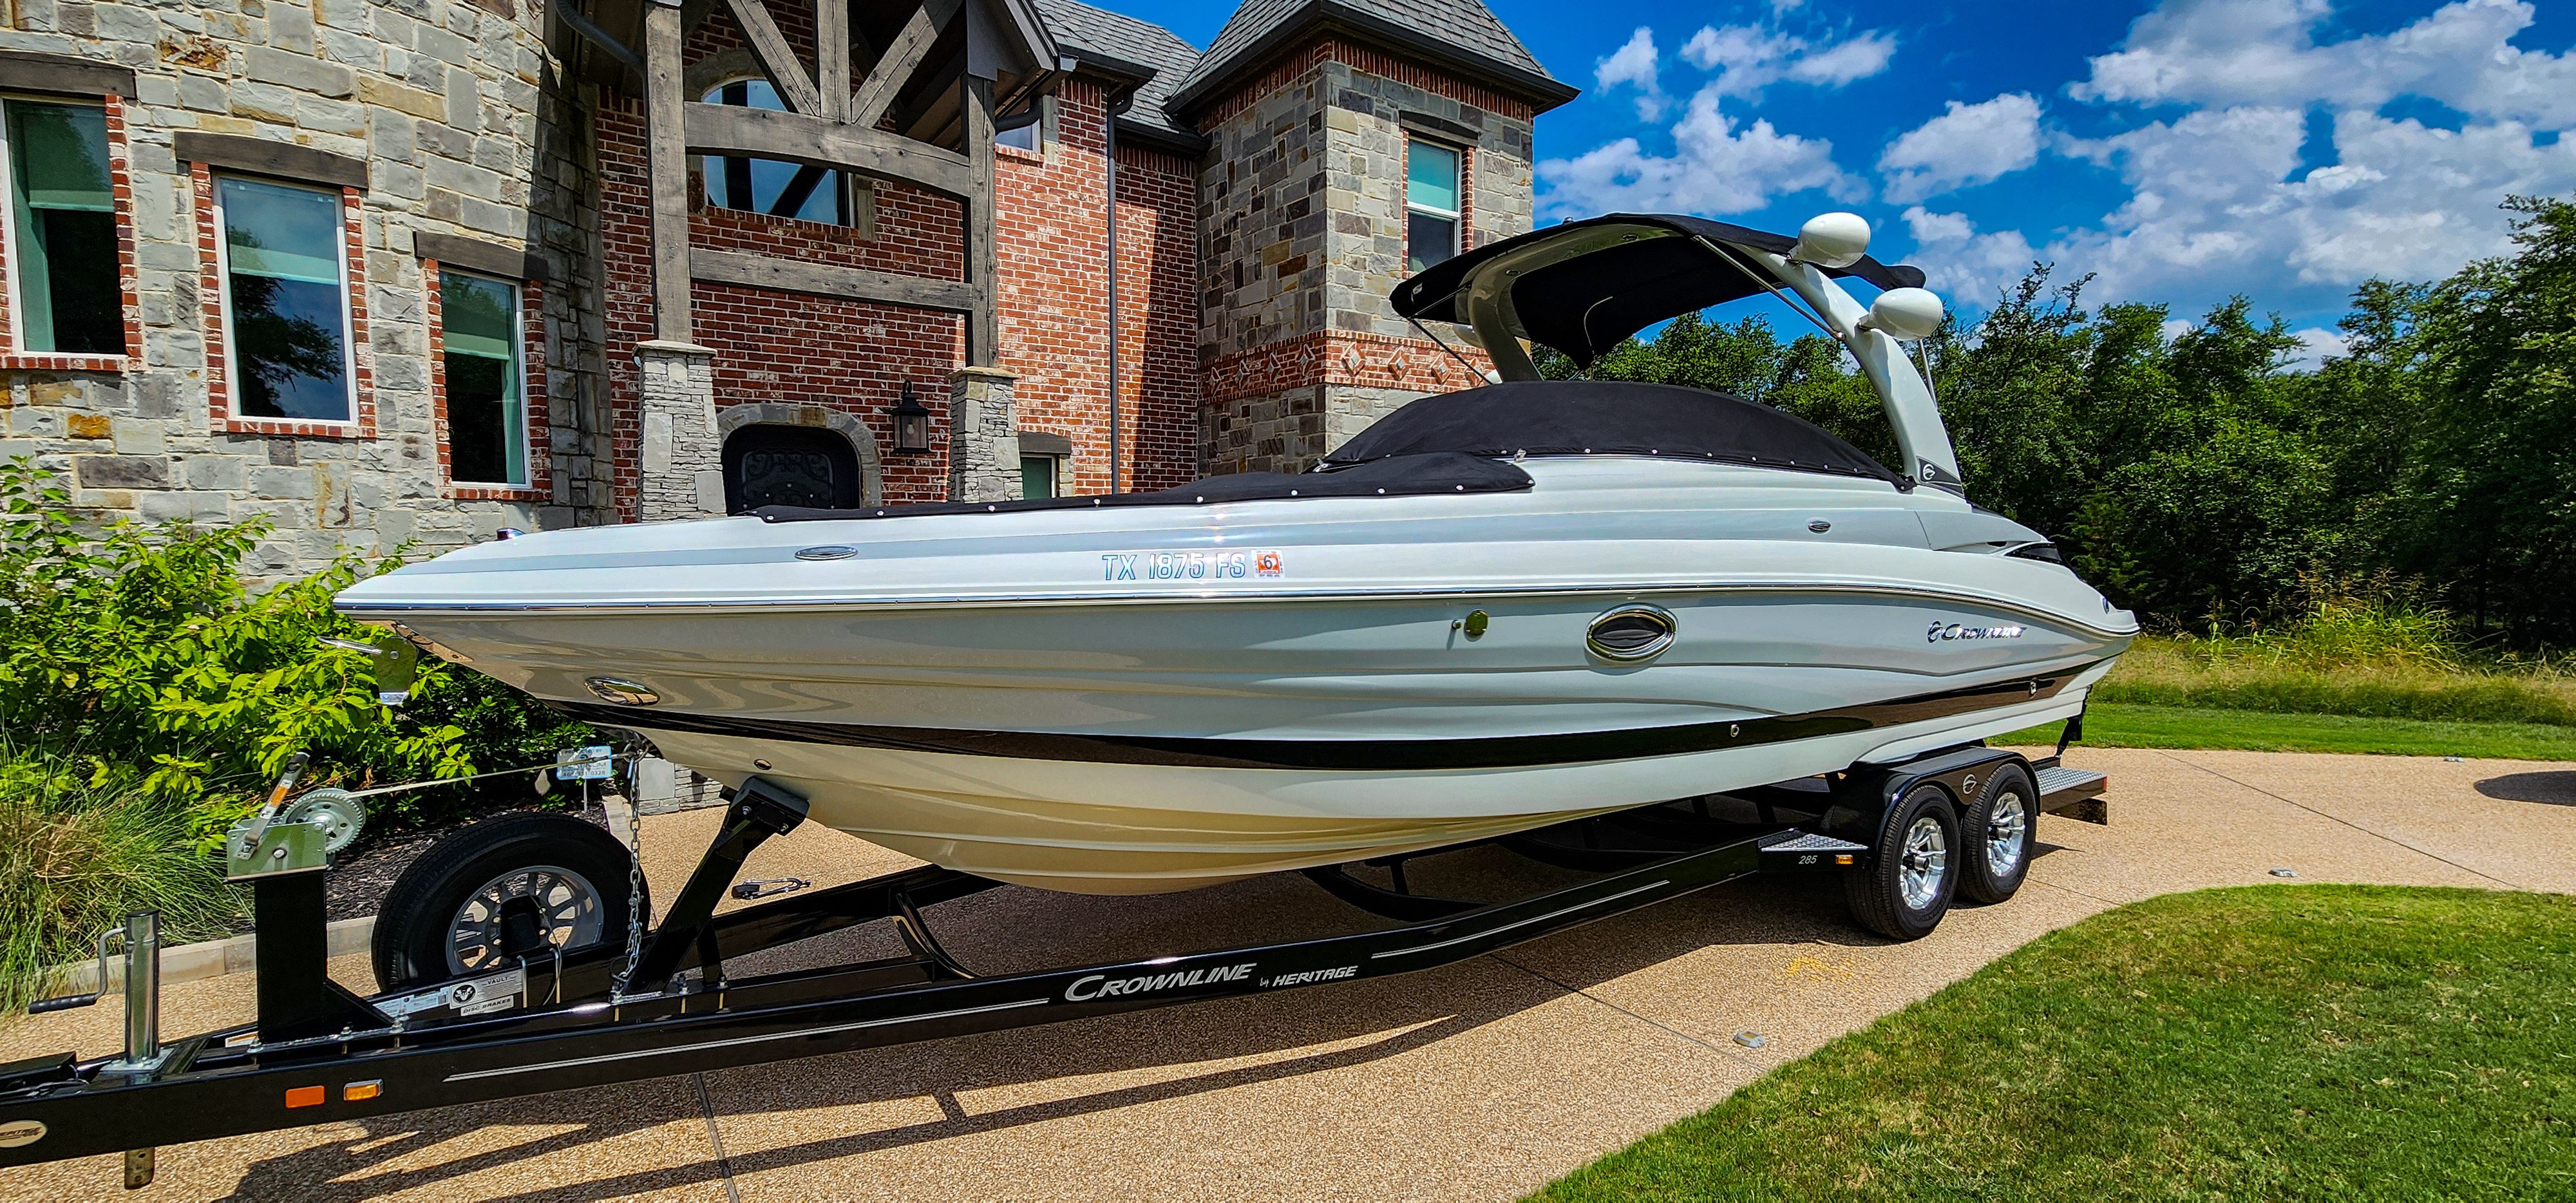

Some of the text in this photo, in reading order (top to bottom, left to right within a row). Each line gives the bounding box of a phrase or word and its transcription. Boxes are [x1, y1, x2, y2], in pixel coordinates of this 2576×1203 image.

[1102, 554, 1137, 581] TX
[1148, 553, 1204, 579] 1875
[1216, 552, 1245, 578] FS
[1264, 554, 1273, 569] 6
[1799, 855, 1818, 864] 285
[488, 976, 509, 985] VAULT
[1065, 963, 1359, 1001] CROWNLINE by HERITAGE
[482, 998, 511, 1009] BRAKES
